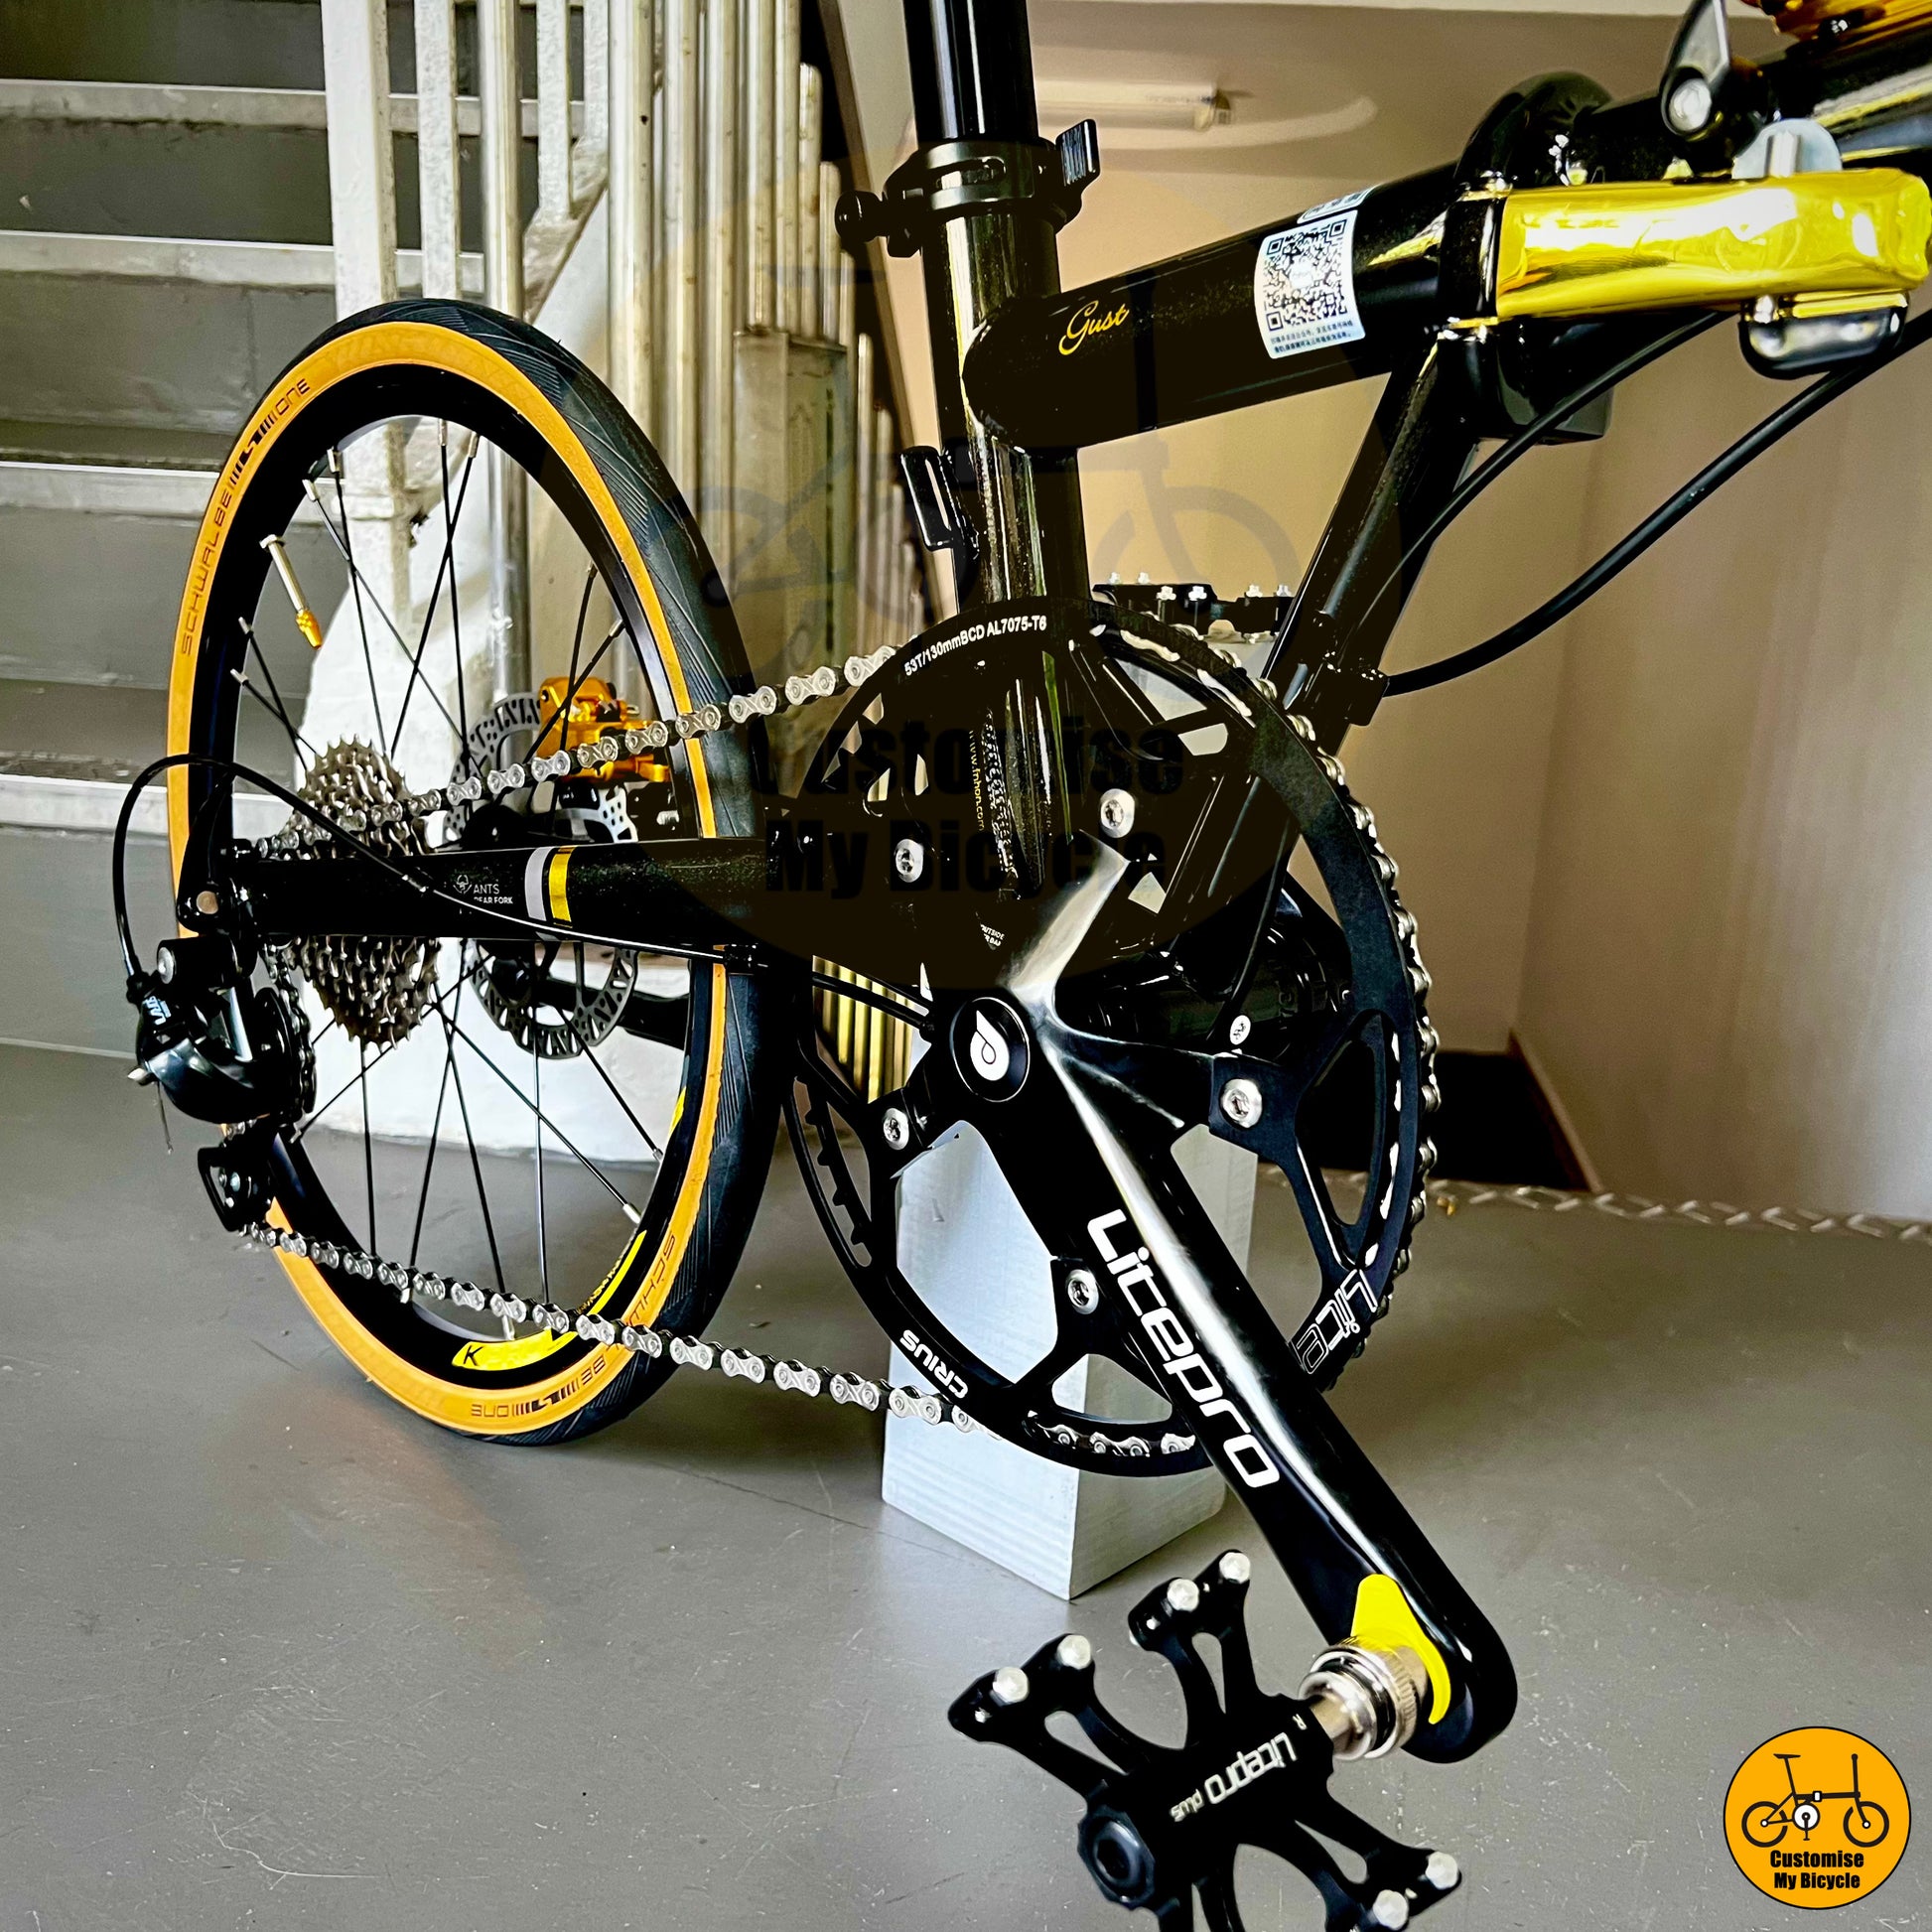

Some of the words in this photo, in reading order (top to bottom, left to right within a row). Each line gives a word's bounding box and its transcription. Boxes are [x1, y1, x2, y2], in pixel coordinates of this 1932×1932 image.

[1058, 300, 1130, 355] Gust
[182, 489, 232, 655] SCHWALBE
[276, 378, 310, 416] ONE
[904, 624, 985, 676] 53T/130mmBCD
[987, 615, 1047, 637] AL7075-T6
[474, 884, 499, 895] ANTS
[581, 1234, 676, 1387] SCHWBE
[1291, 1269, 1378, 1374] Lite
[899, 1329, 968, 1399] CRIUS
[1087, 1208, 1280, 1488] Litepro
[471, 1404, 509, 1417] ONE
[1293, 1714, 1308, 1730] R
[1204, 1731, 1297, 1805] Litepro
[1170, 1788, 1204, 1822] plus
